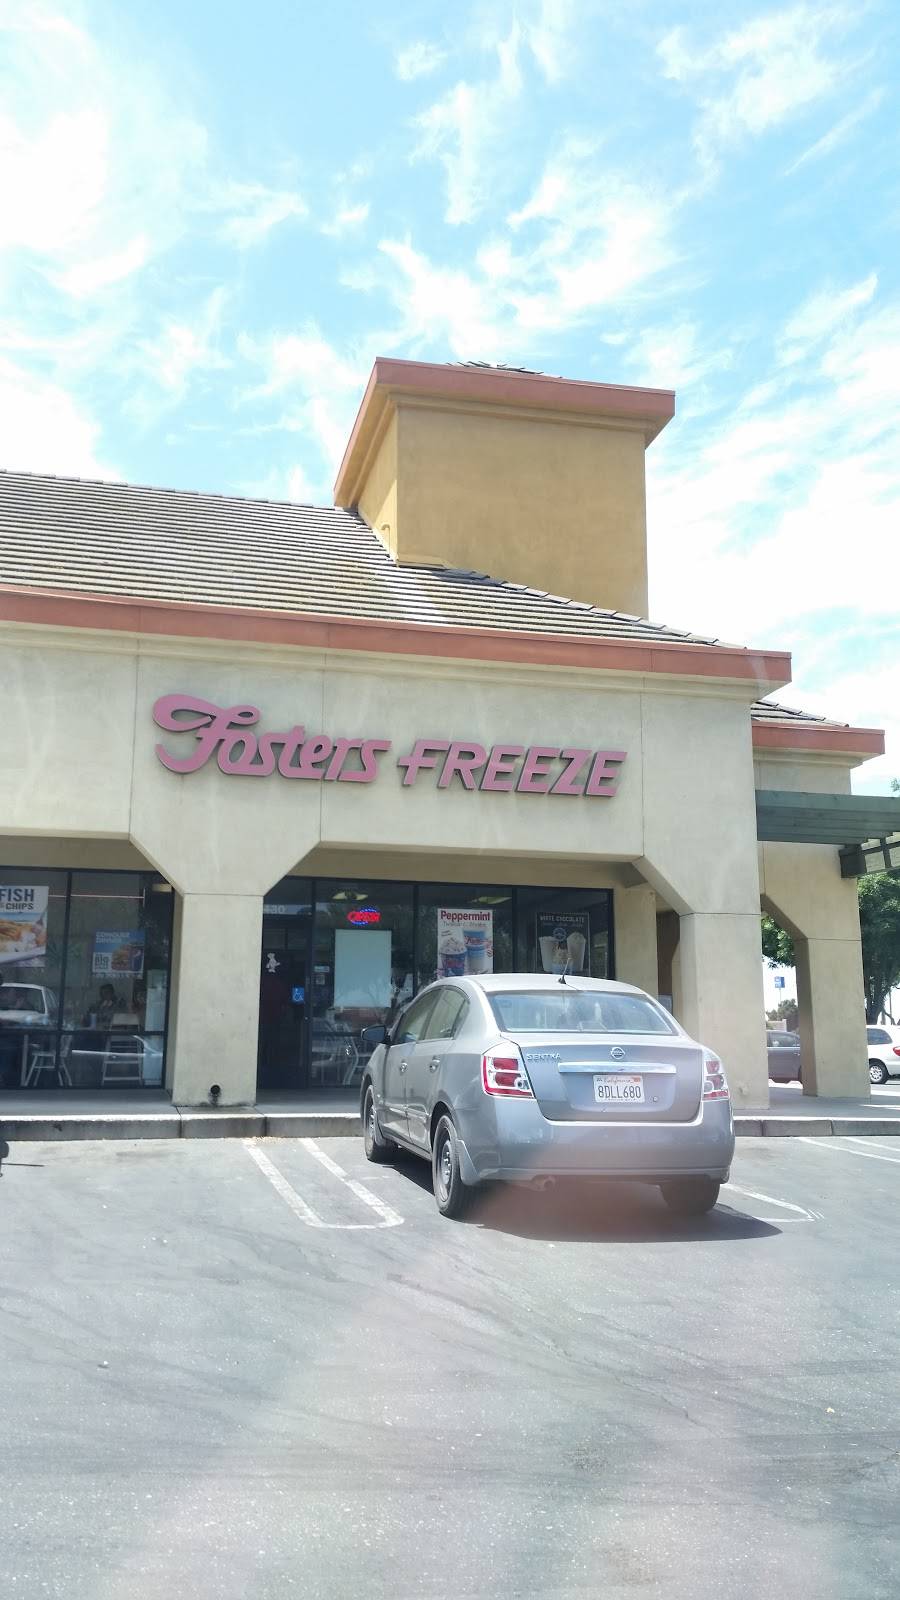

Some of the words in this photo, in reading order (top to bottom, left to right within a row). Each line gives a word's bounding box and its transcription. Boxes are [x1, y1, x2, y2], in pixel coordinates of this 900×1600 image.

[152, 694, 391, 784] Fosters
[398, 739, 628, 797] FREEZE
[0, 888, 35, 902] FISH
[6, 902, 34, 910] CHIPS
[441, 910, 490, 922] Peppermint
[598, 1085, 642, 1098] 8DLL680
